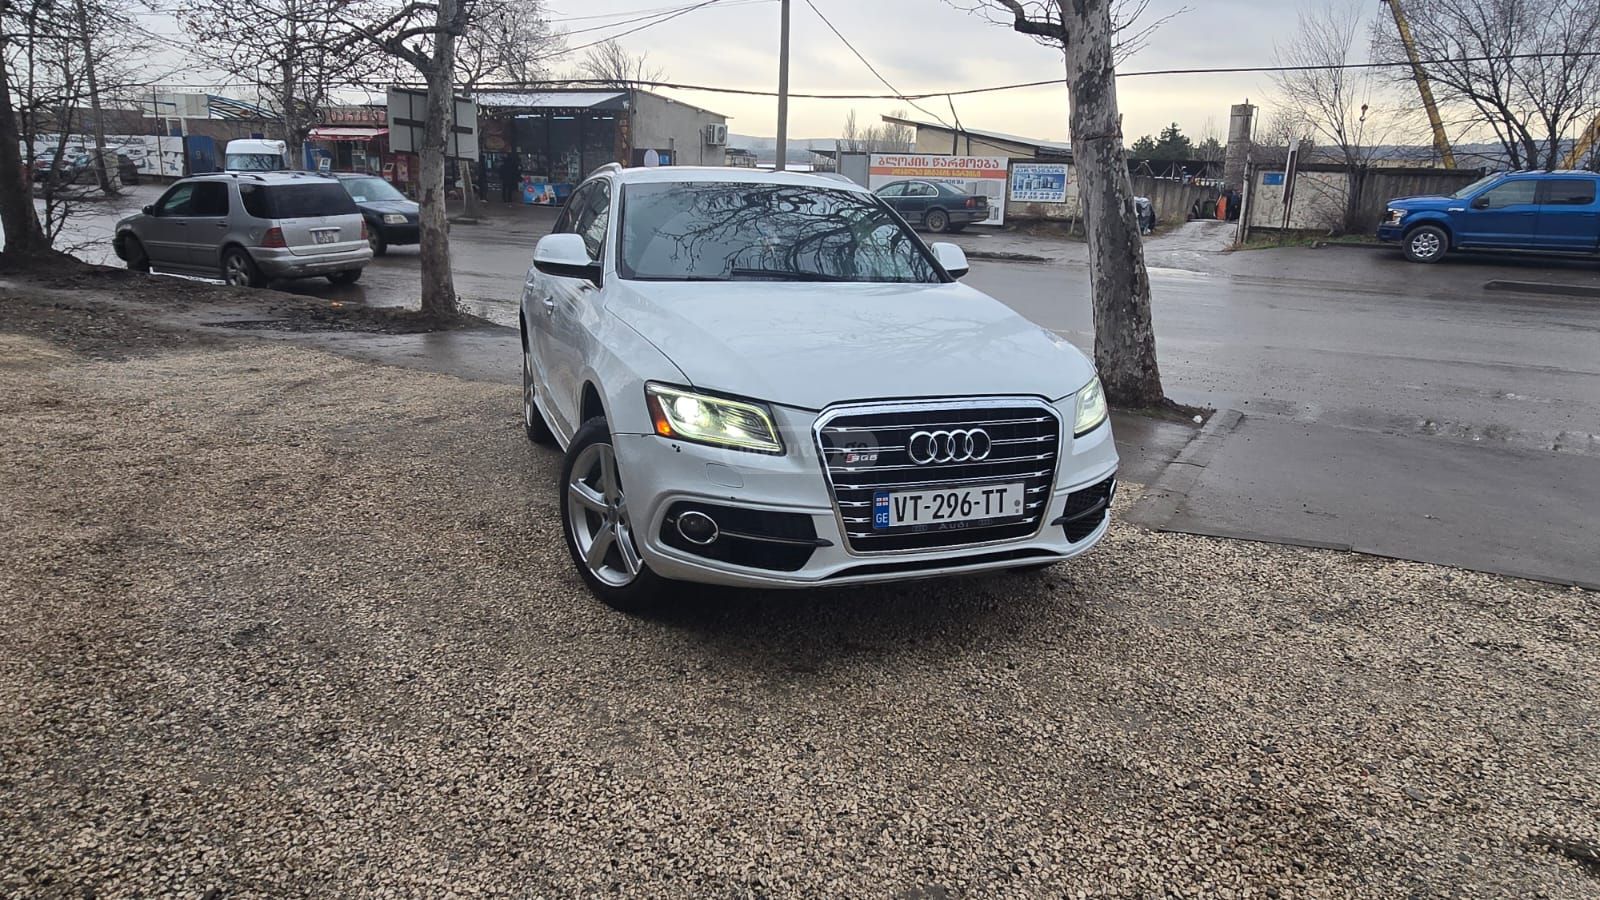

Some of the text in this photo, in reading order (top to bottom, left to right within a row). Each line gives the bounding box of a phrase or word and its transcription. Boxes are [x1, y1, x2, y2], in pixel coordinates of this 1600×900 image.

[879, 157, 999, 169] ბლოკის წარმოება
[895, 488, 1008, 522] VT-296-TT
[876, 513, 888, 523] GE
[938, 522, 969, 531] Audi
